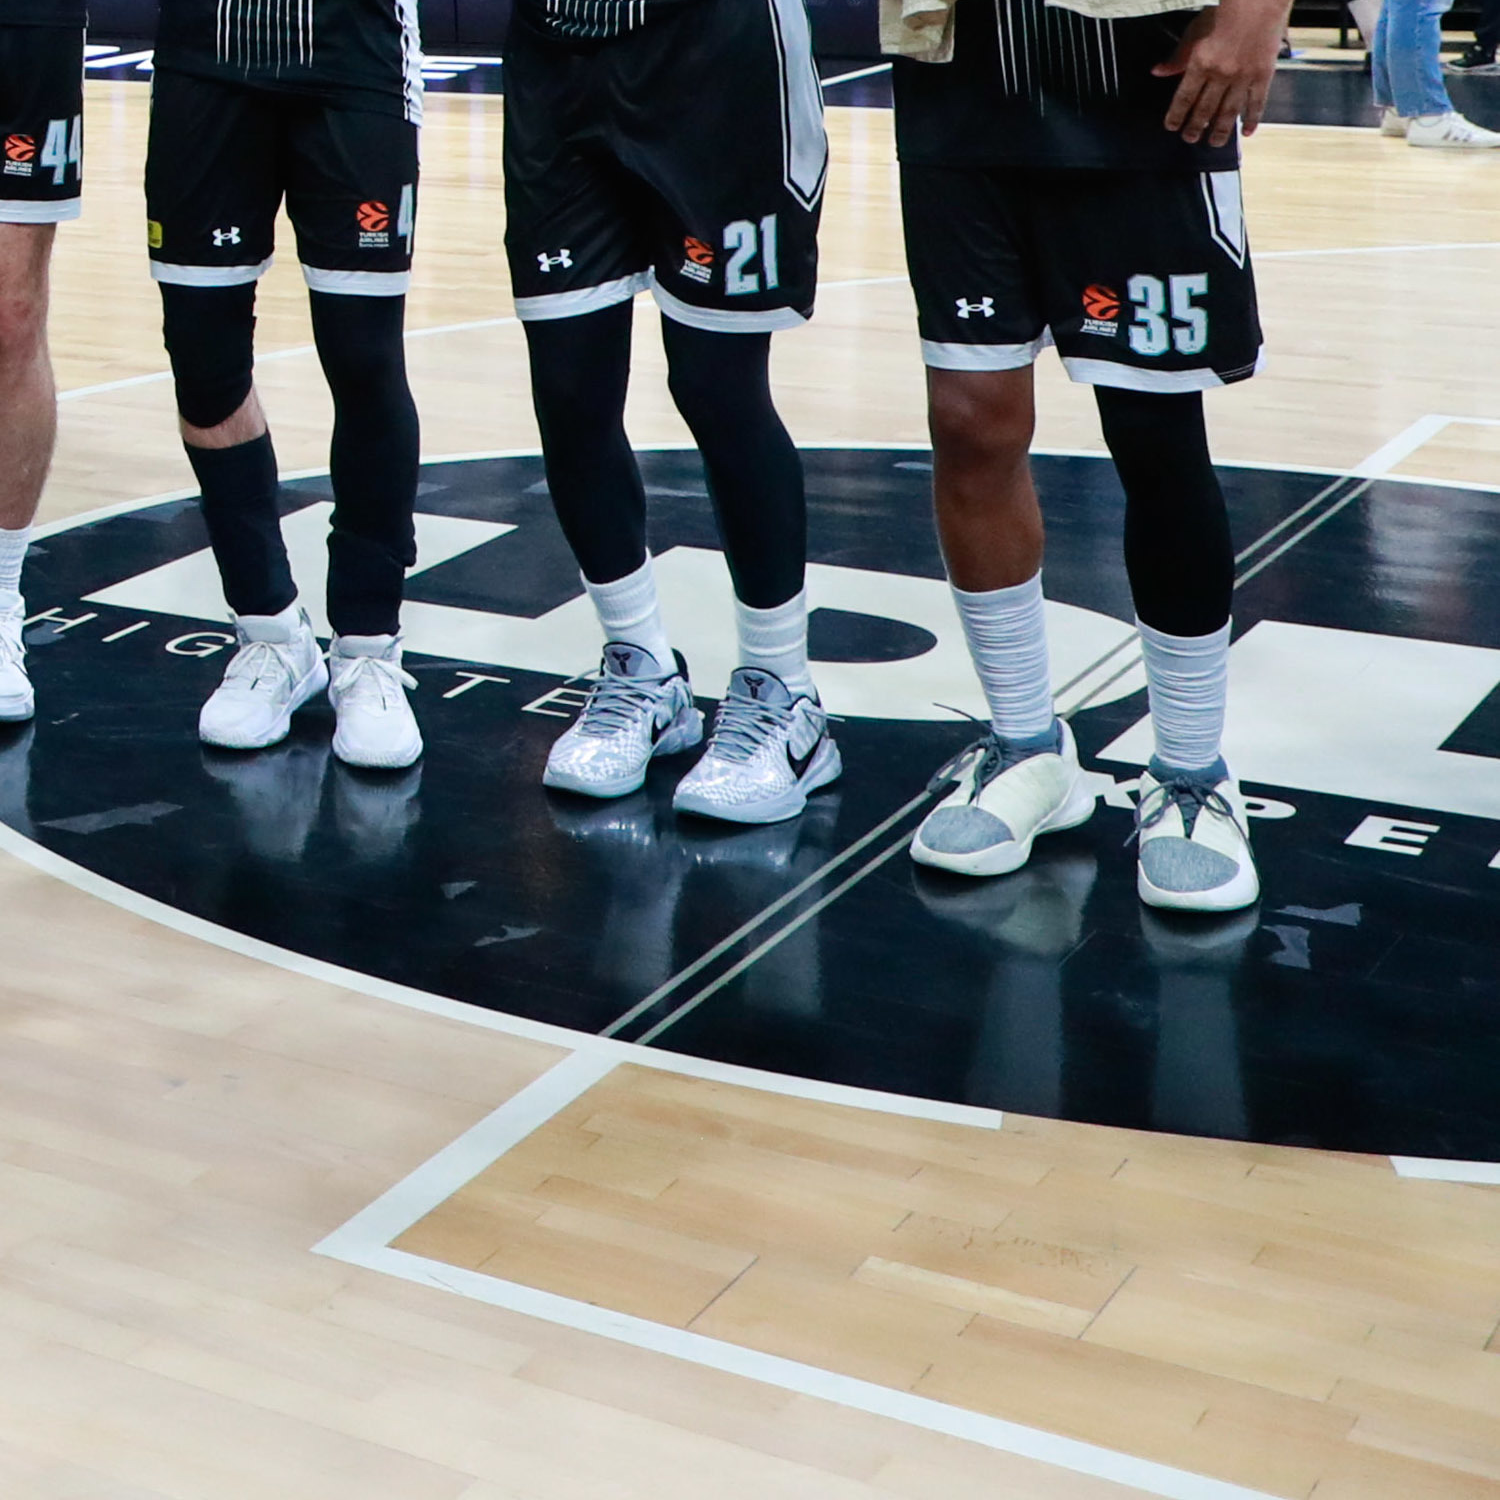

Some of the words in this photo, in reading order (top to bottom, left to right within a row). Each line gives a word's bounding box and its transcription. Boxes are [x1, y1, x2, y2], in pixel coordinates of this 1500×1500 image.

[723, 212, 779, 296] 21
[1127, 271, 1209, 357] 35
[22, 606, 237, 659] HIG
[443, 671, 593, 719] TE
